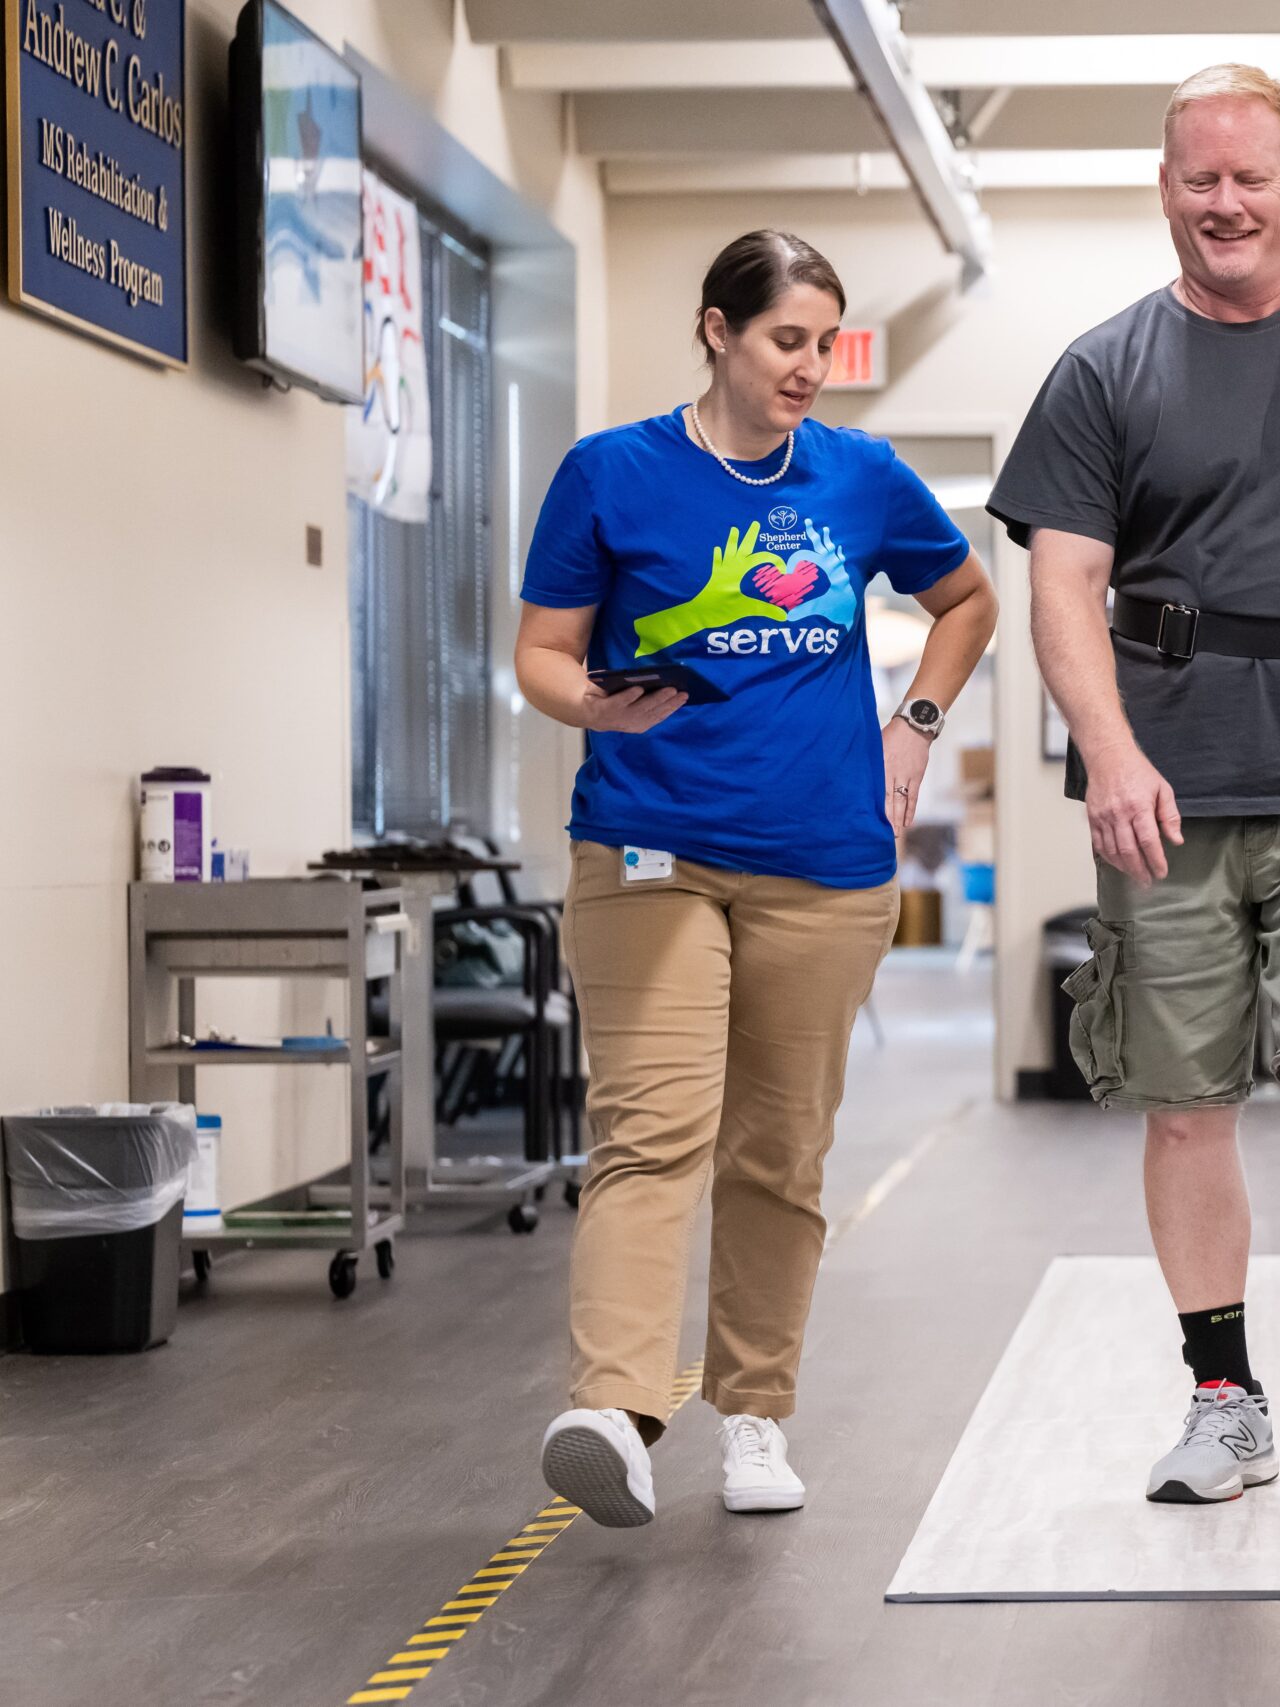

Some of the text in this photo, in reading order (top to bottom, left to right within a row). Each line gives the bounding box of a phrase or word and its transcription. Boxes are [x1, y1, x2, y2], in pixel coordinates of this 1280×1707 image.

[23, 0, 182, 149] Andrew C. Carlos
[42, 118, 168, 232] MS Rehabilitation &
[48, 207, 163, 308] Wellness Program
[759, 532, 808, 544] Shepherd
[766, 541, 802, 551] Center
[707, 627, 840, 655] serves
